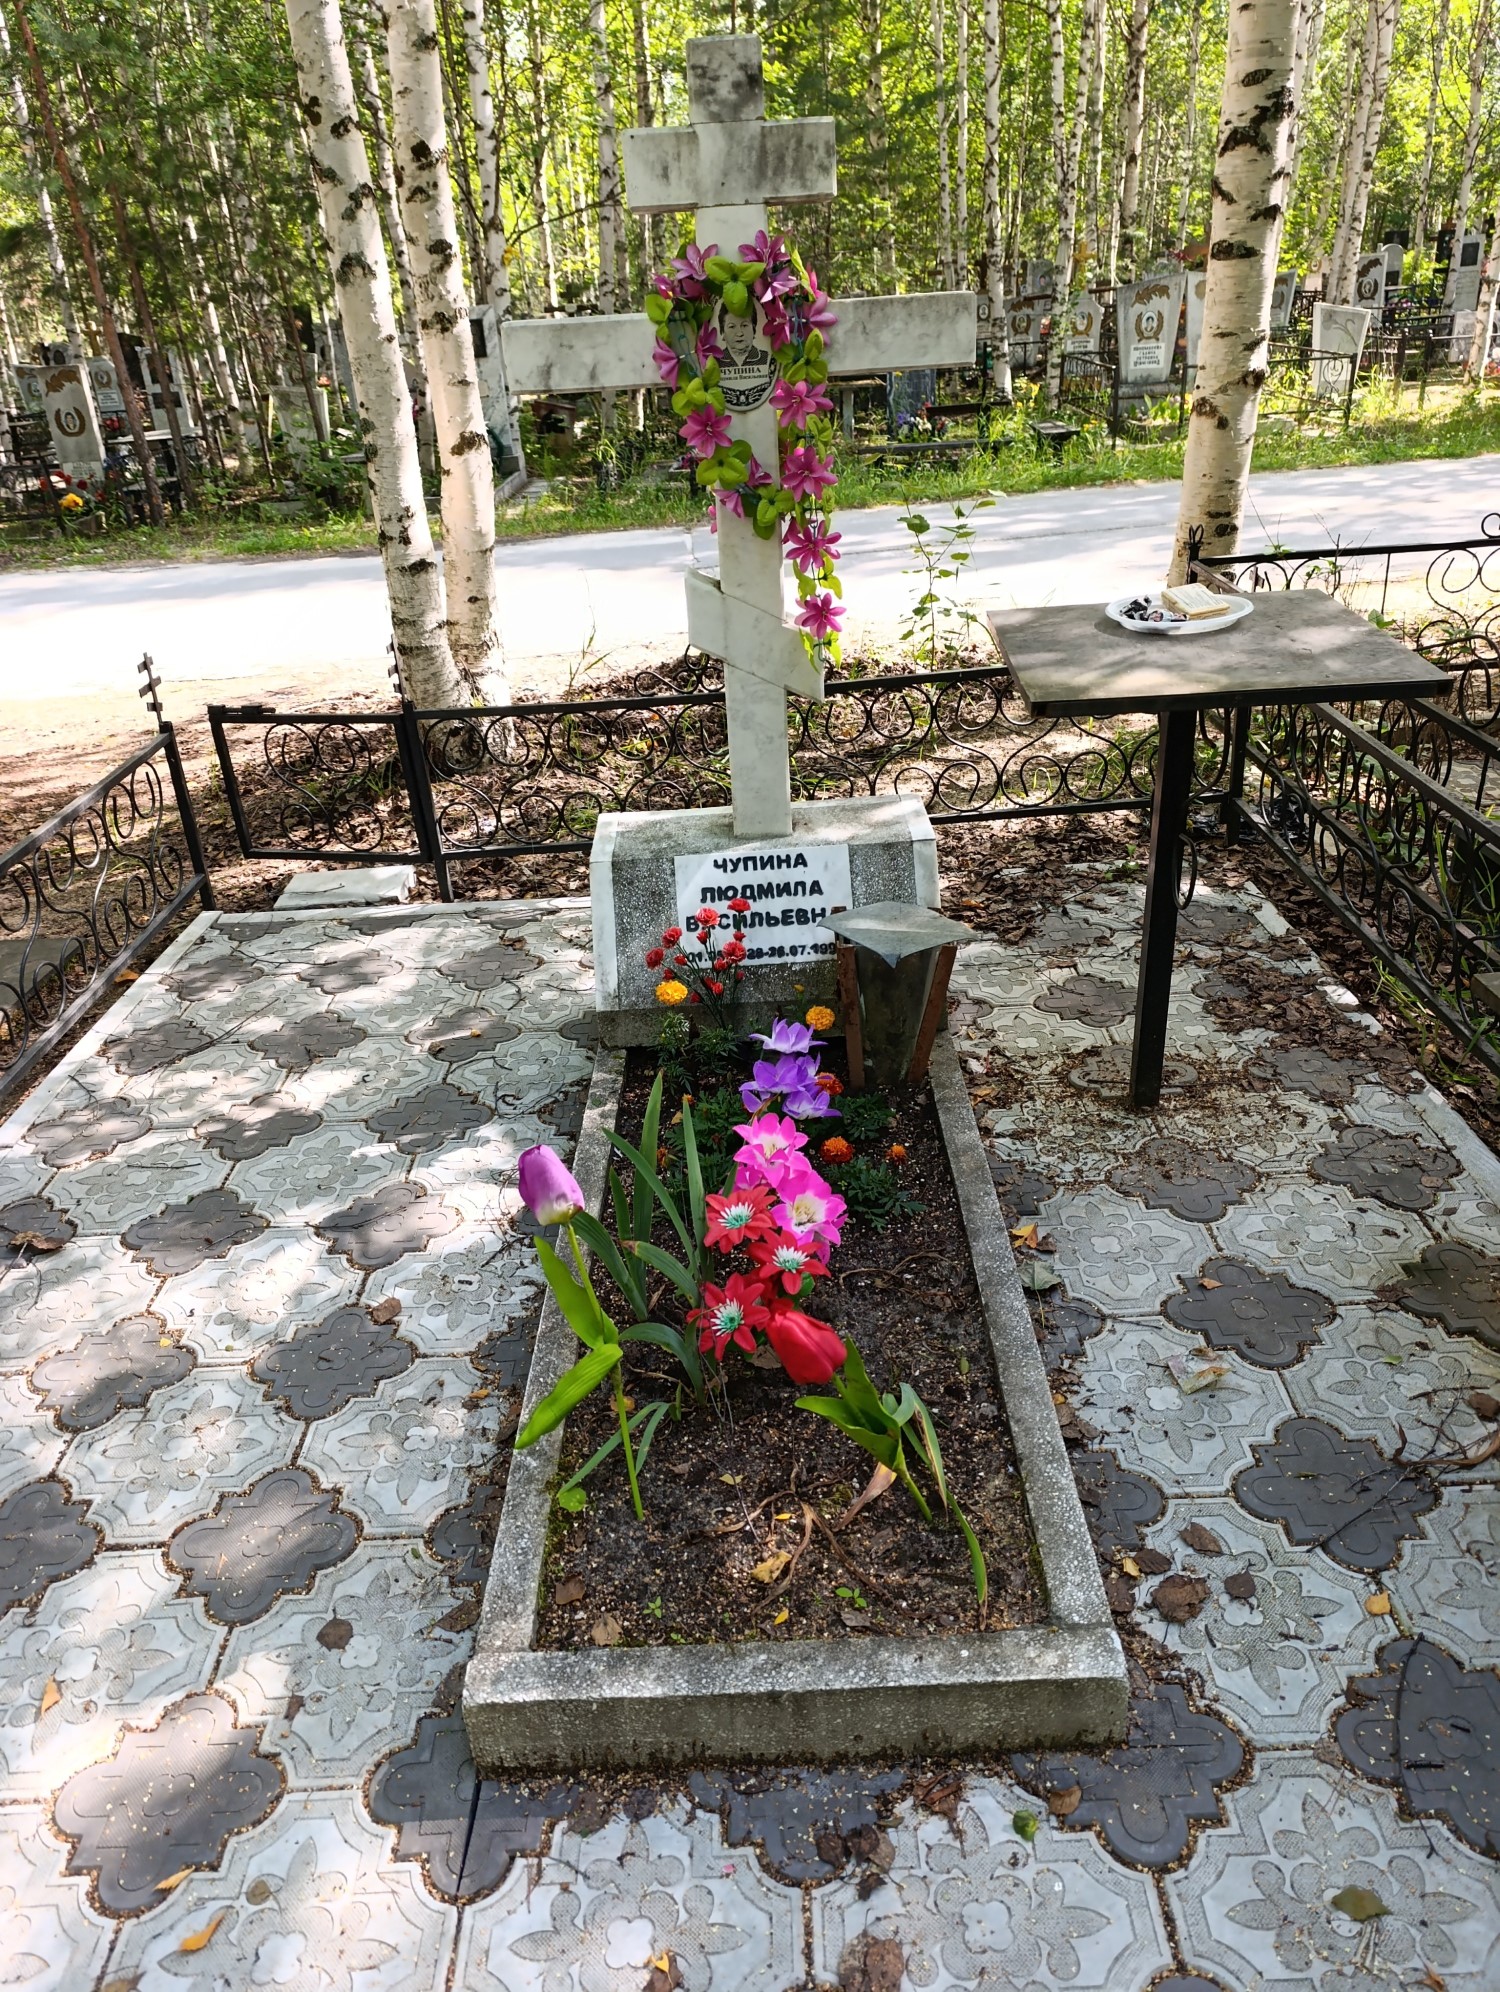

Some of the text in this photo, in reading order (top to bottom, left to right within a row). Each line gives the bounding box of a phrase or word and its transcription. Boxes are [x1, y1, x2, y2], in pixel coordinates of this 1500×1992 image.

[720, 366, 761, 375] ЧУПИНА
[713, 853, 808, 873] ЧУПИНА
[700, 880, 824, 903] ЛЮДМИЛА
[685, 907, 827, 932] ВСИЛЬЕВН
